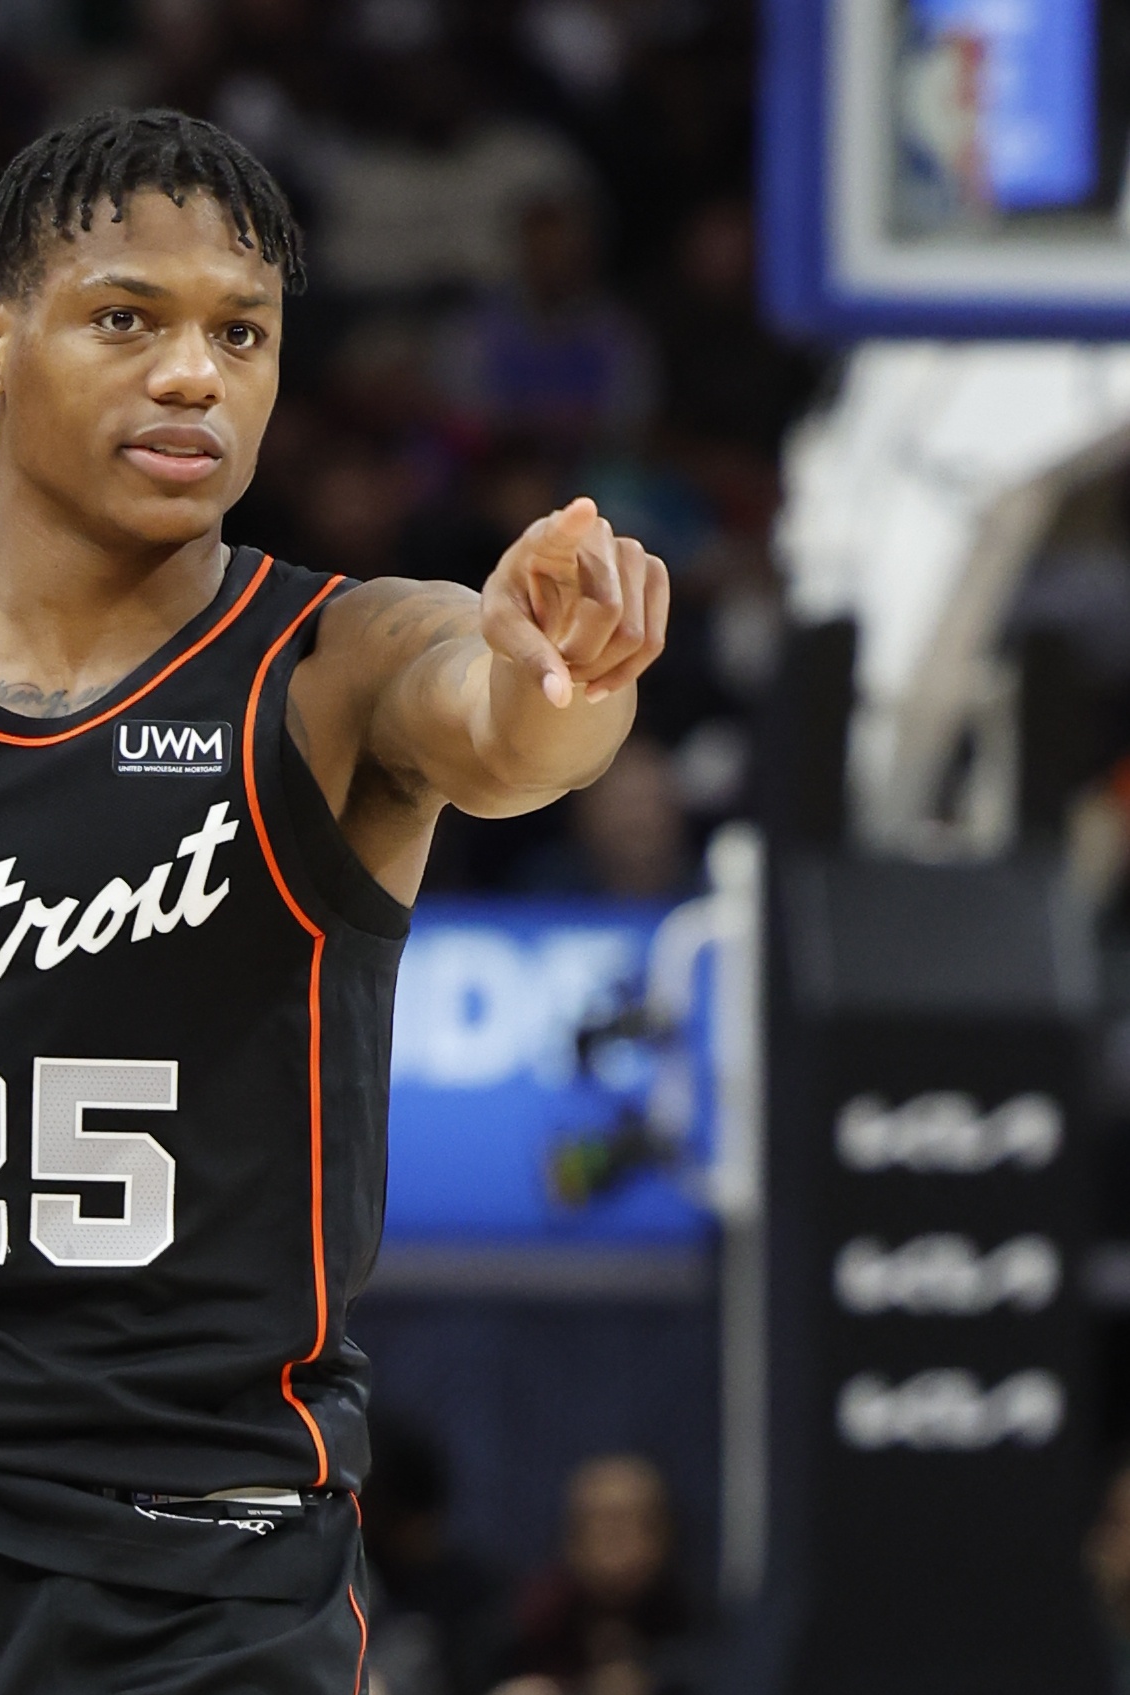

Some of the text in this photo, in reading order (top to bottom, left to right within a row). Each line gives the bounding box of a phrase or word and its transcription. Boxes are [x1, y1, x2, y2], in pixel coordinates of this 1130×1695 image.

[119, 725, 223, 760] UWM
[144, 765, 183, 773] WHOLESALE
[184, 765, 223, 774] MORTGAGE
